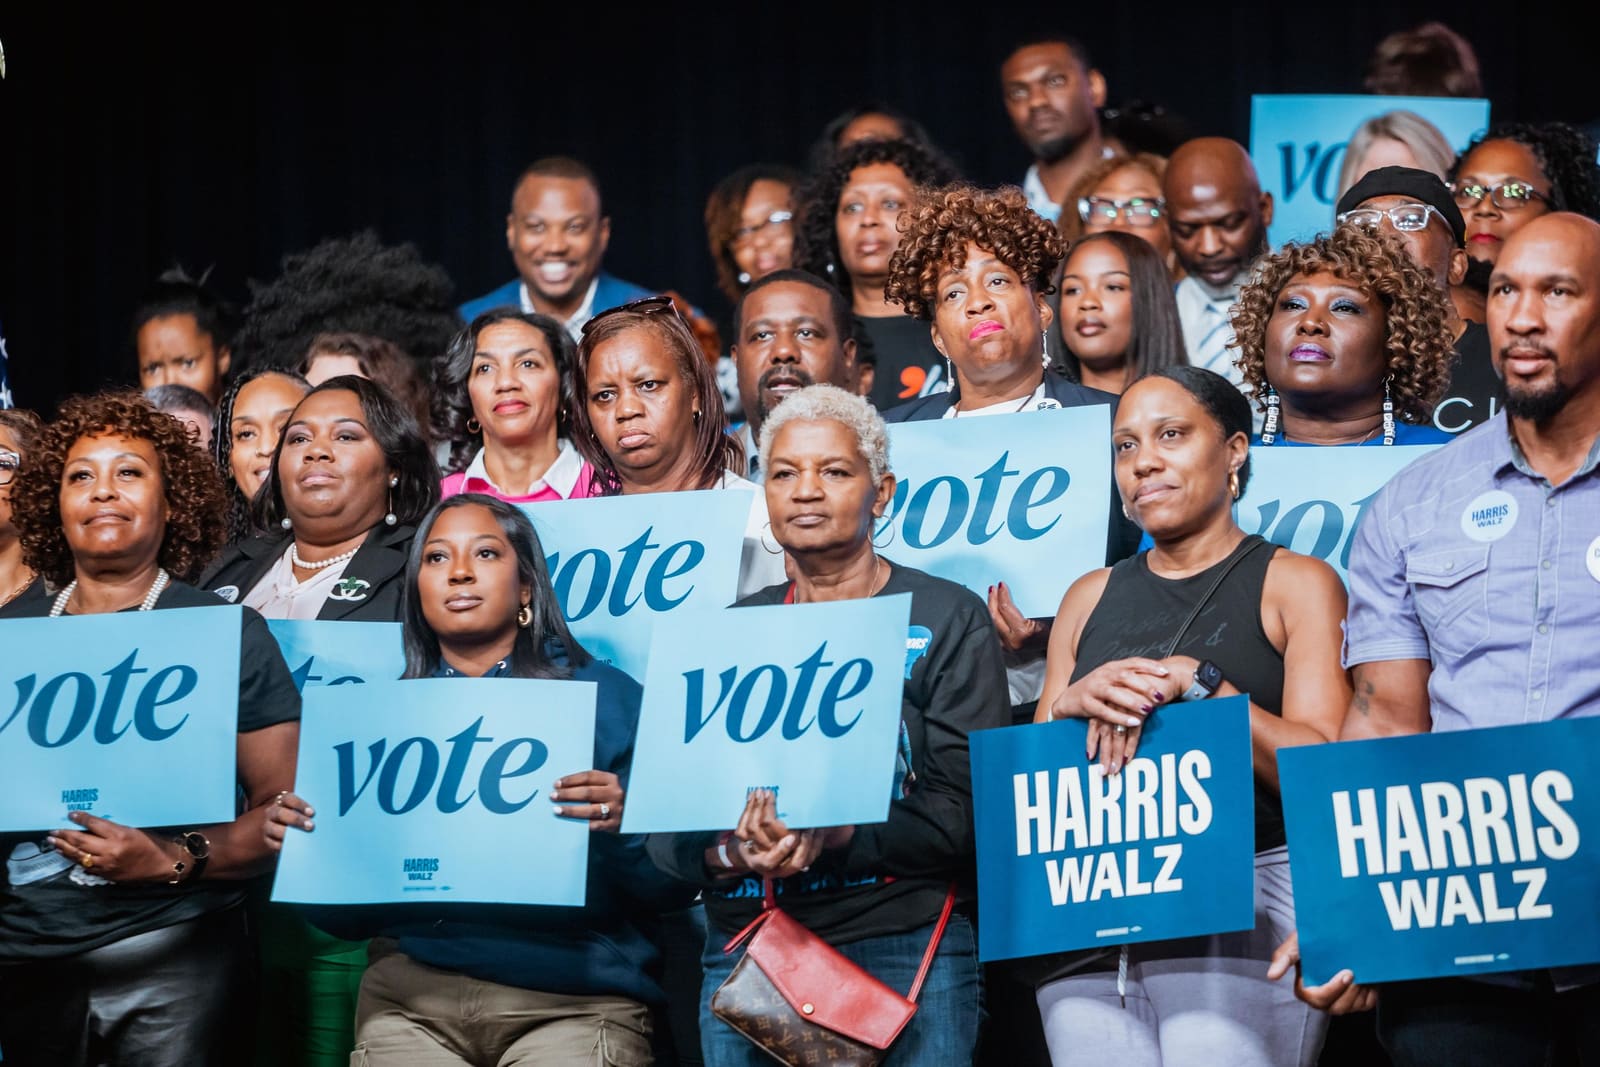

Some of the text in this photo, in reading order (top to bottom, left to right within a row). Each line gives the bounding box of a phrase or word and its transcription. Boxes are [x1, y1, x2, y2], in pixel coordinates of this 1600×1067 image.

[1277, 142, 1348, 206] vo
[1471, 504, 1509, 522] HARRIS
[1477, 517, 1503, 528] WALZ
[546, 525, 705, 623] ote
[682, 640, 874, 744] vote
[62, 788, 99, 803] HARRIS
[333, 716, 548, 817] vote
[67, 802, 93, 811] WALZ
[1013, 749, 1213, 857] HARRIS
[1332, 770, 1581, 878] HARRIS
[403, 857, 440, 873] HARRIS
[408, 872, 433, 881] WALZ
[1045, 844, 1183, 906] WALZ
[1378, 868, 1554, 931] WALZ
